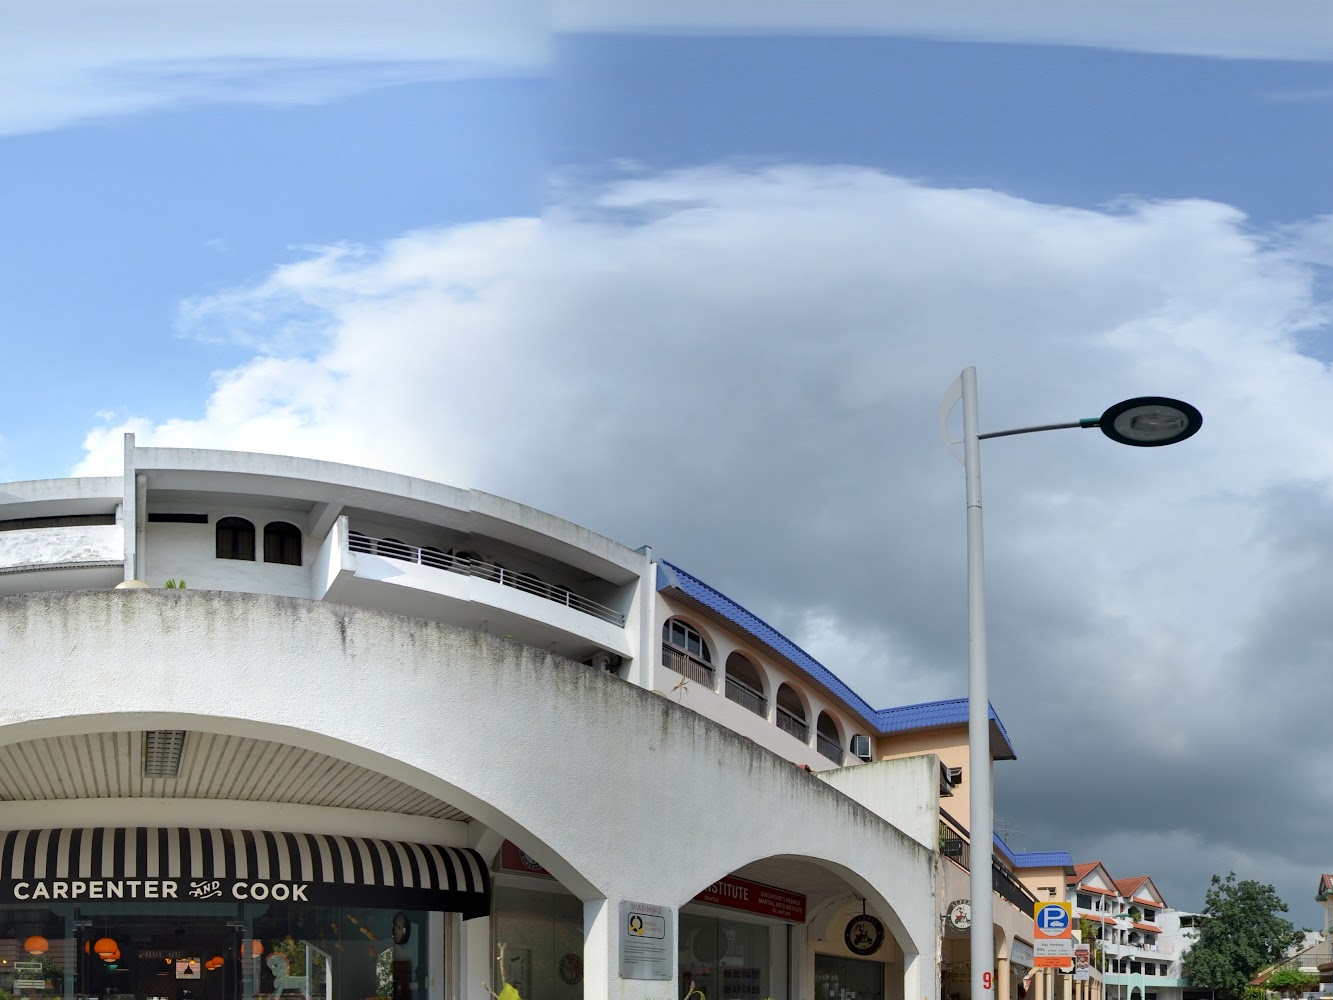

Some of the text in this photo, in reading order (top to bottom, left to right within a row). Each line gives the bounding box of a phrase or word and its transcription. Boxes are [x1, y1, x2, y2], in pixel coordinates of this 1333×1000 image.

[13, 880, 309, 901] CARPENTER AND COOK
[704, 881, 749, 901] NSTITUTE
[630, 902, 662, 915] WARNING
[1043, 907, 1066, 928] P
[983, 971, 992, 990] 9
